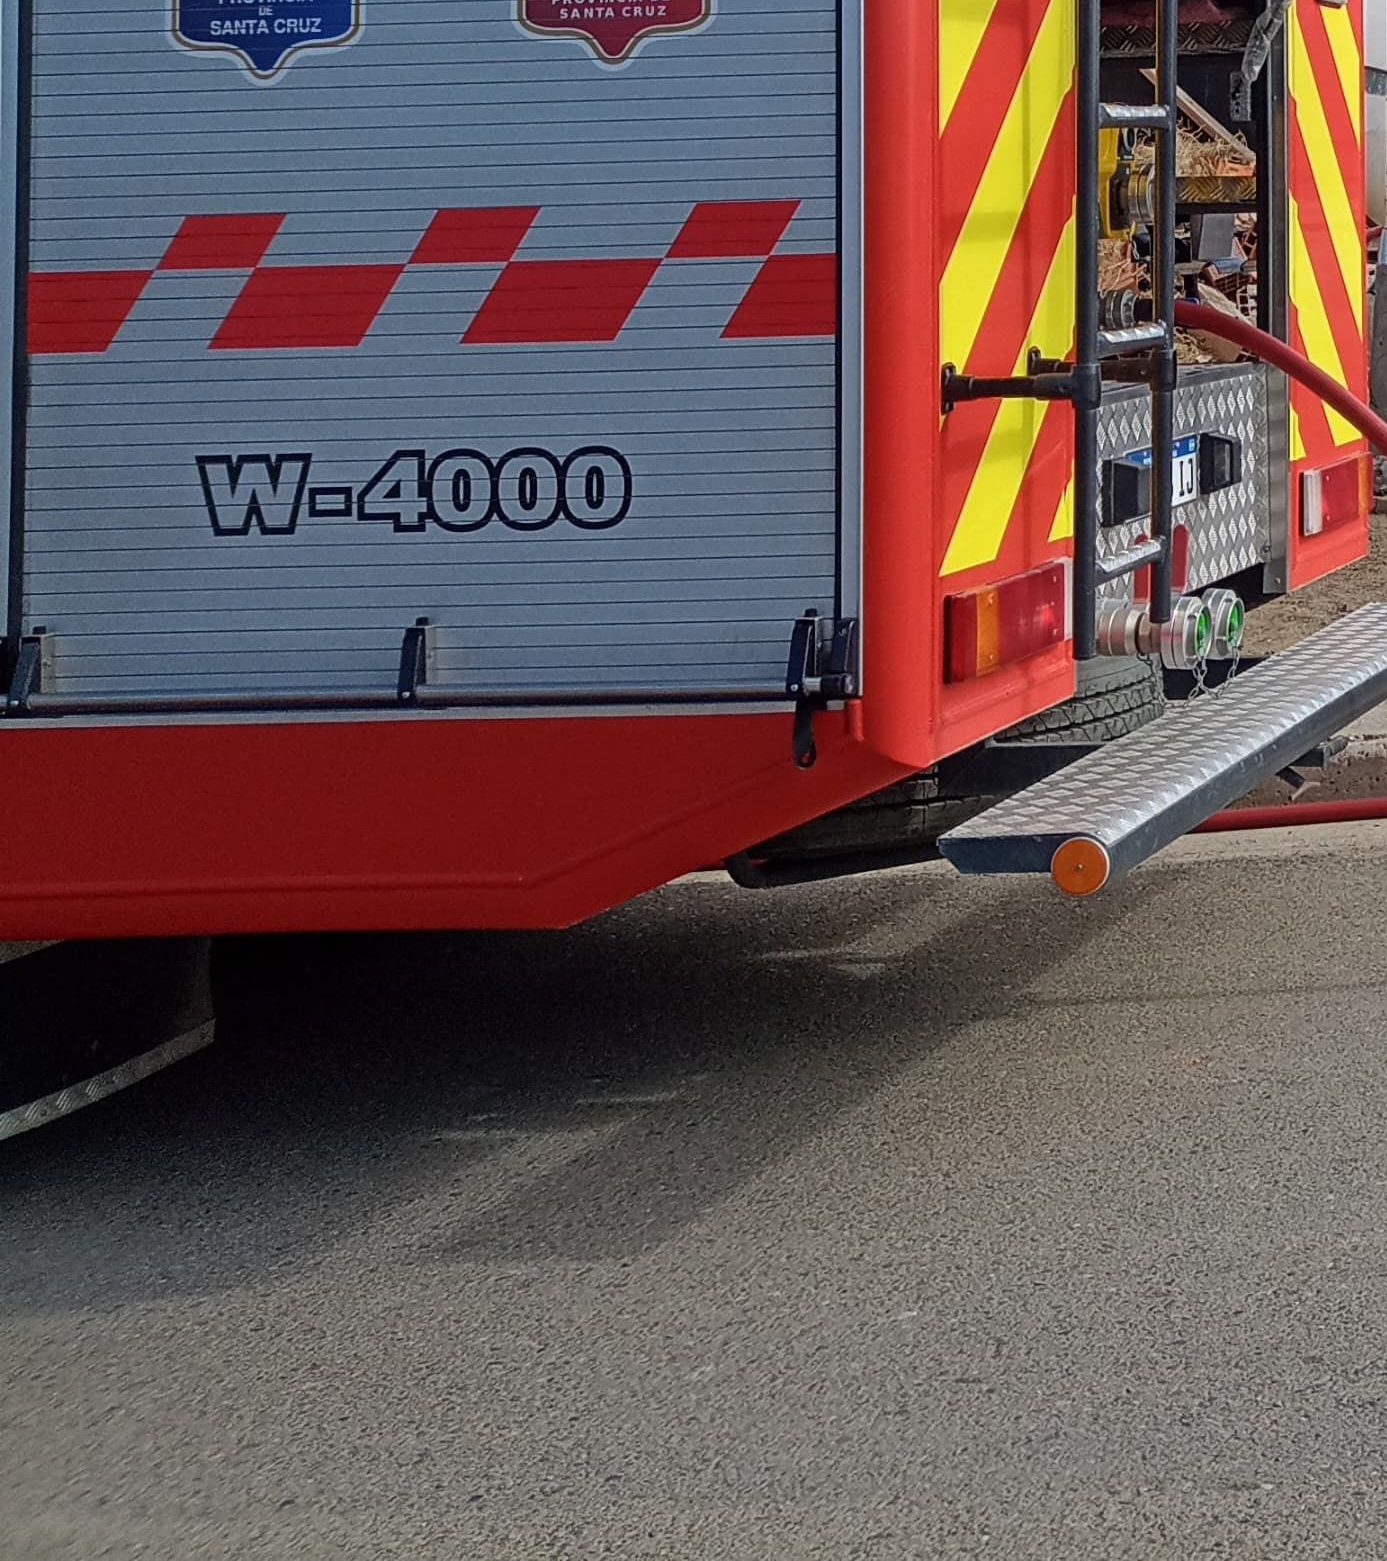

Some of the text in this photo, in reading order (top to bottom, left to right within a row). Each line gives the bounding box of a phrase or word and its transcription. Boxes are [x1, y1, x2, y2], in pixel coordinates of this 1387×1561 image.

[258, 5, 274, 17] DE
[559, 5, 667, 20] SANTA CRUZ
[209, 17, 322, 37] SANTA CRUZ
[195, 445, 633, 536] W-4000
